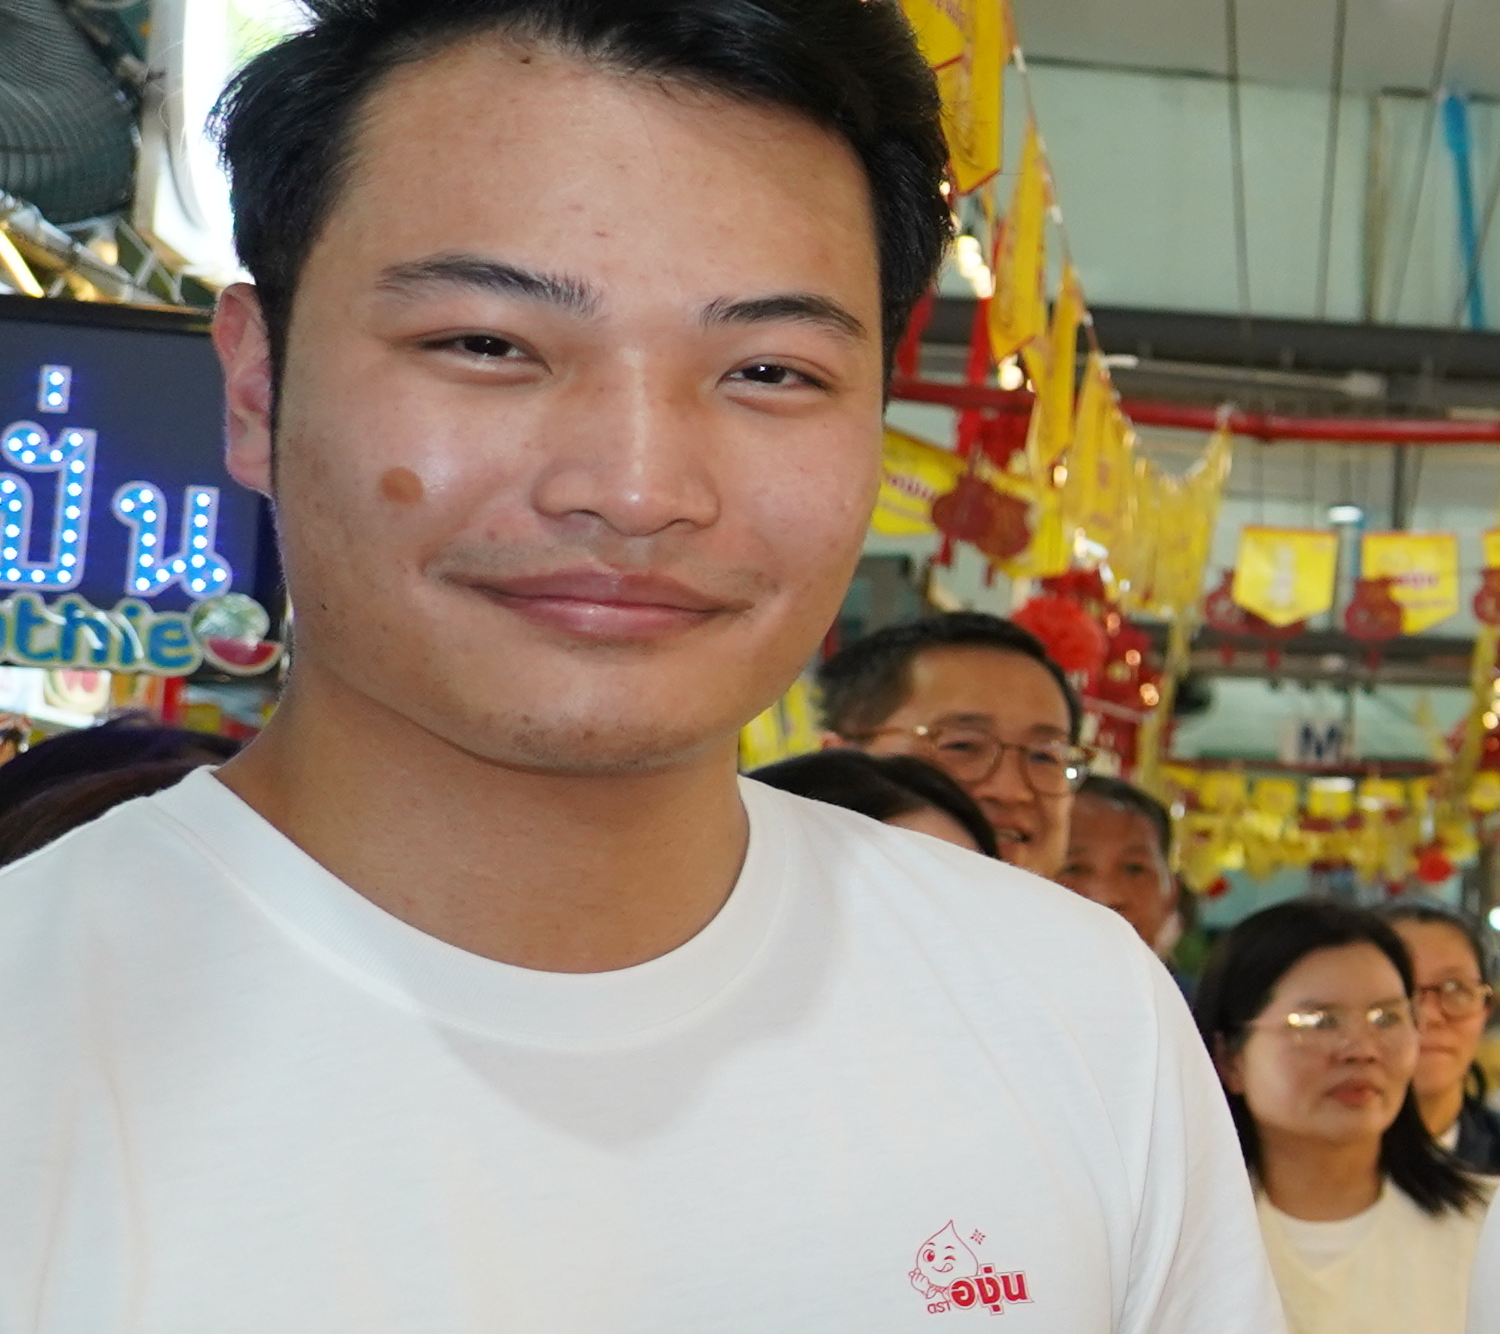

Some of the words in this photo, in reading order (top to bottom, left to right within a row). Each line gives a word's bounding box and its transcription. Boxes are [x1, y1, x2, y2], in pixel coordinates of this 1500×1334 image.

[0, 598, 196, 668] thie
[927, 1300, 951, 1315] ตรา
[950, 1265, 1030, 1314] องุ่น
